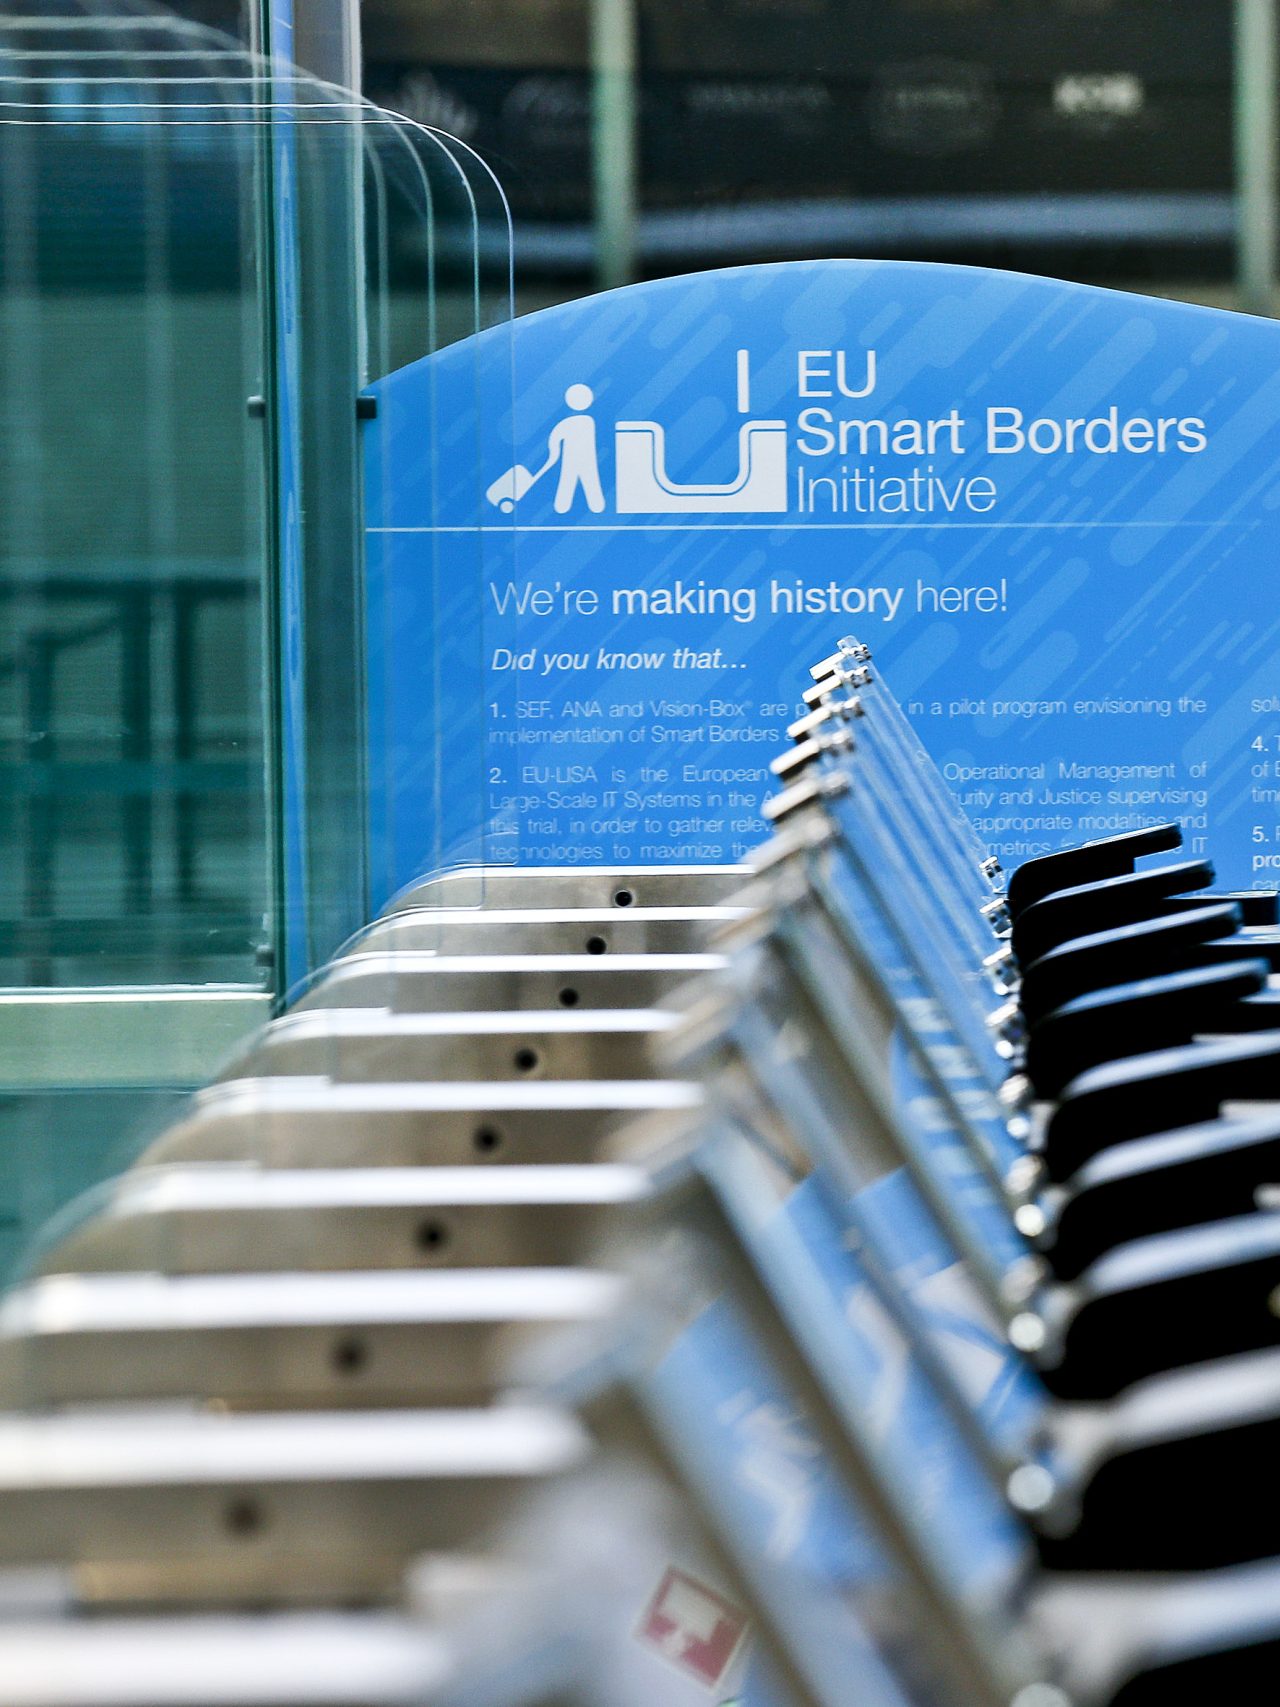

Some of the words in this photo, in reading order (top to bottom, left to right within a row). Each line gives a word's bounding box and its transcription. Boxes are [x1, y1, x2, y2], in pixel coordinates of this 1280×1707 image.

[797, 349, 877, 398] EU
[797, 408, 965, 455] Smart
[986, 406, 1208, 455] Borders
[797, 466, 997, 513] Initiative
[491, 581, 599, 616] We're
[612, 579, 756, 623] making
[769, 577, 902, 622] history
[917, 577, 1007, 613] here!
[491, 648, 537, 673] Did
[543, 653, 590, 675] you
[596, 646, 664, 671] know
[673, 646, 748, 671] that...
[489, 701, 507, 718] 1.
[515, 701, 554, 720] SEF,
[561, 701, 603, 718] ANA
[608, 701, 645, 718] and
[759, 704, 788, 717] are
[908, 697, 925, 714] in
[930, 701, 943, 714] a
[948, 697, 987, 718] pilot
[991, 700, 1068, 718] program
[1073, 696, 1172, 717] envisioning
[1177, 696, 1207, 713] the
[488, 725, 624, 747] implementation
[628, 725, 646, 742] of
[650, 725, 705, 742] Smart
[708, 724, 779, 742] Borders
[488, 767, 508, 784] 2.
[522, 766, 598, 784] EU-LISA
[611, 766, 627, 783] is
[639, 766, 669, 783] the
[682, 766, 769, 787] European
[943, 762, 1046, 783] Operational
[1058, 760, 1176, 782] Management
[1189, 760, 1208, 777] of
[489, 792, 598, 813] Large-Scale
[623, 791, 702, 813] Systems
[706, 791, 723, 808] in
[728, 791, 756, 808] the
[999, 788, 1035, 805] and
[1038, 787, 1102, 805] Justice
[1107, 786, 1209, 808] supervising
[527, 817, 562, 837] trial,
[590, 817, 638, 834] order
[667, 816, 725, 838] gather
[972, 813, 1073, 835] appropriate
[640, 841, 723, 859] maximize
